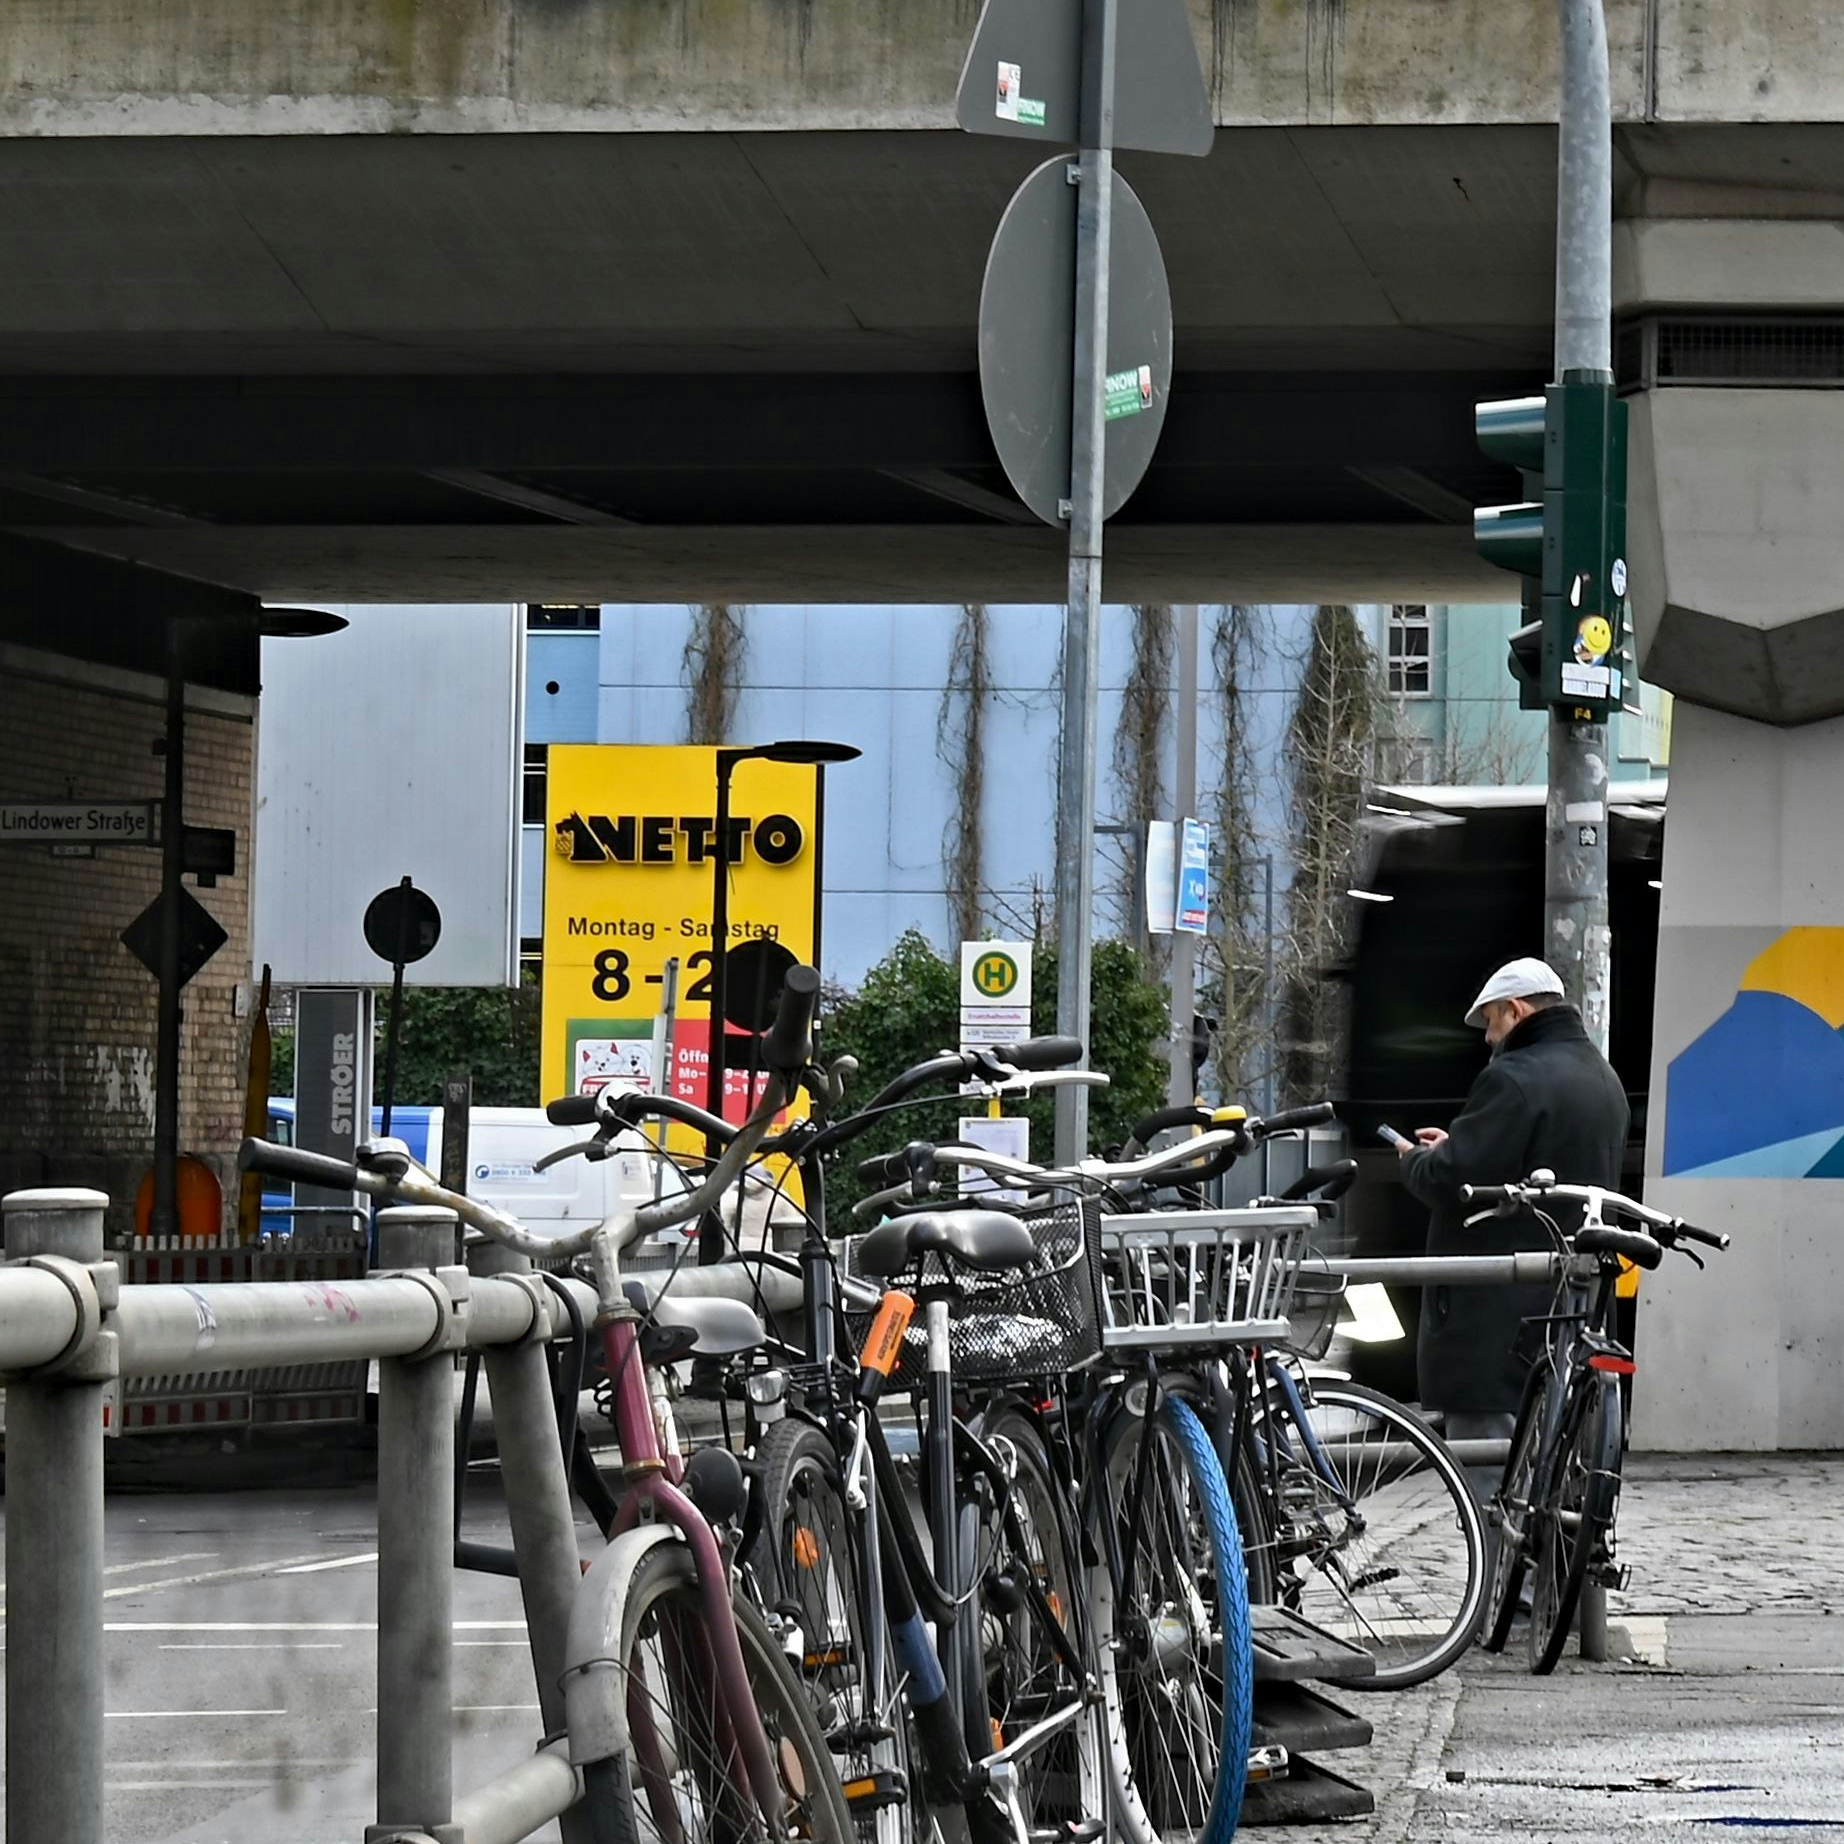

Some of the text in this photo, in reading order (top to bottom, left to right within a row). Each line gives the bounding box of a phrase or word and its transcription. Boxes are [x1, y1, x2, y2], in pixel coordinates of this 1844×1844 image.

[2, 809, 145, 836] Lindower Straße
[569, 814, 804, 864] NETTO
[568, 917, 655, 939] Montag
[592, 949, 630, 1001] 8
[984, 963, 1005, 987] H
[330, 1033, 354, 1135] STRÖER
